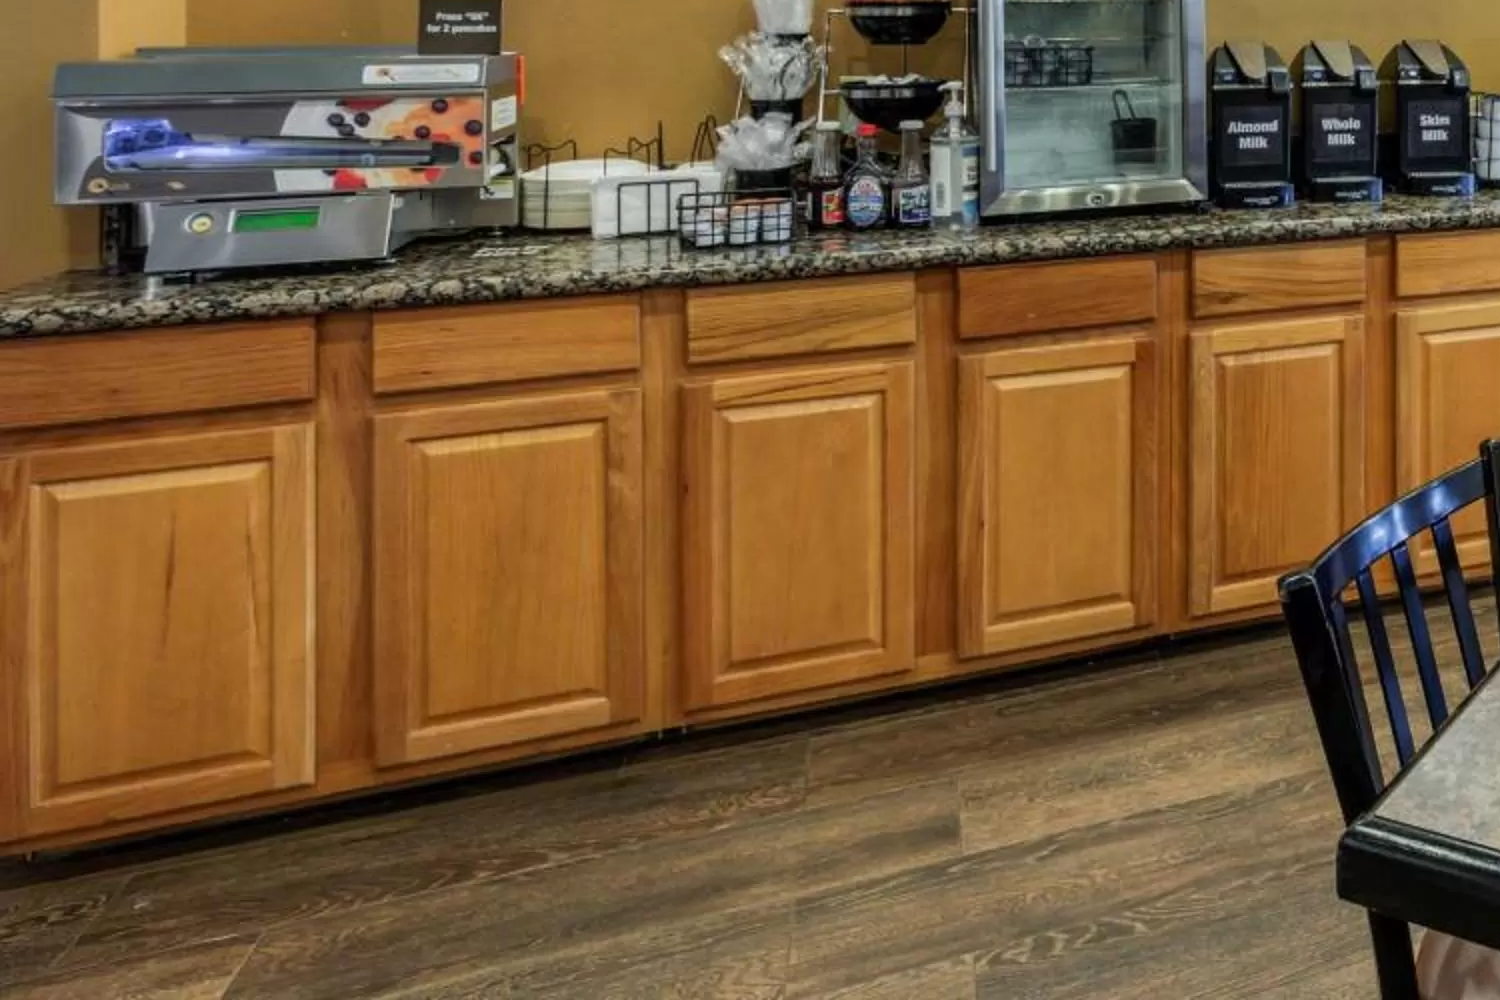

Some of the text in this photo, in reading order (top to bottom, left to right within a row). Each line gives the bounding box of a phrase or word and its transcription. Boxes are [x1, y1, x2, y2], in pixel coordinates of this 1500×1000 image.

[1227, 120, 1278, 134] Almond
[1321, 117, 1361, 131] Whole
[1239, 135, 1268, 149] Milk
[1327, 133, 1355, 145] Milk
[1422, 129, 1449, 141] Milk
